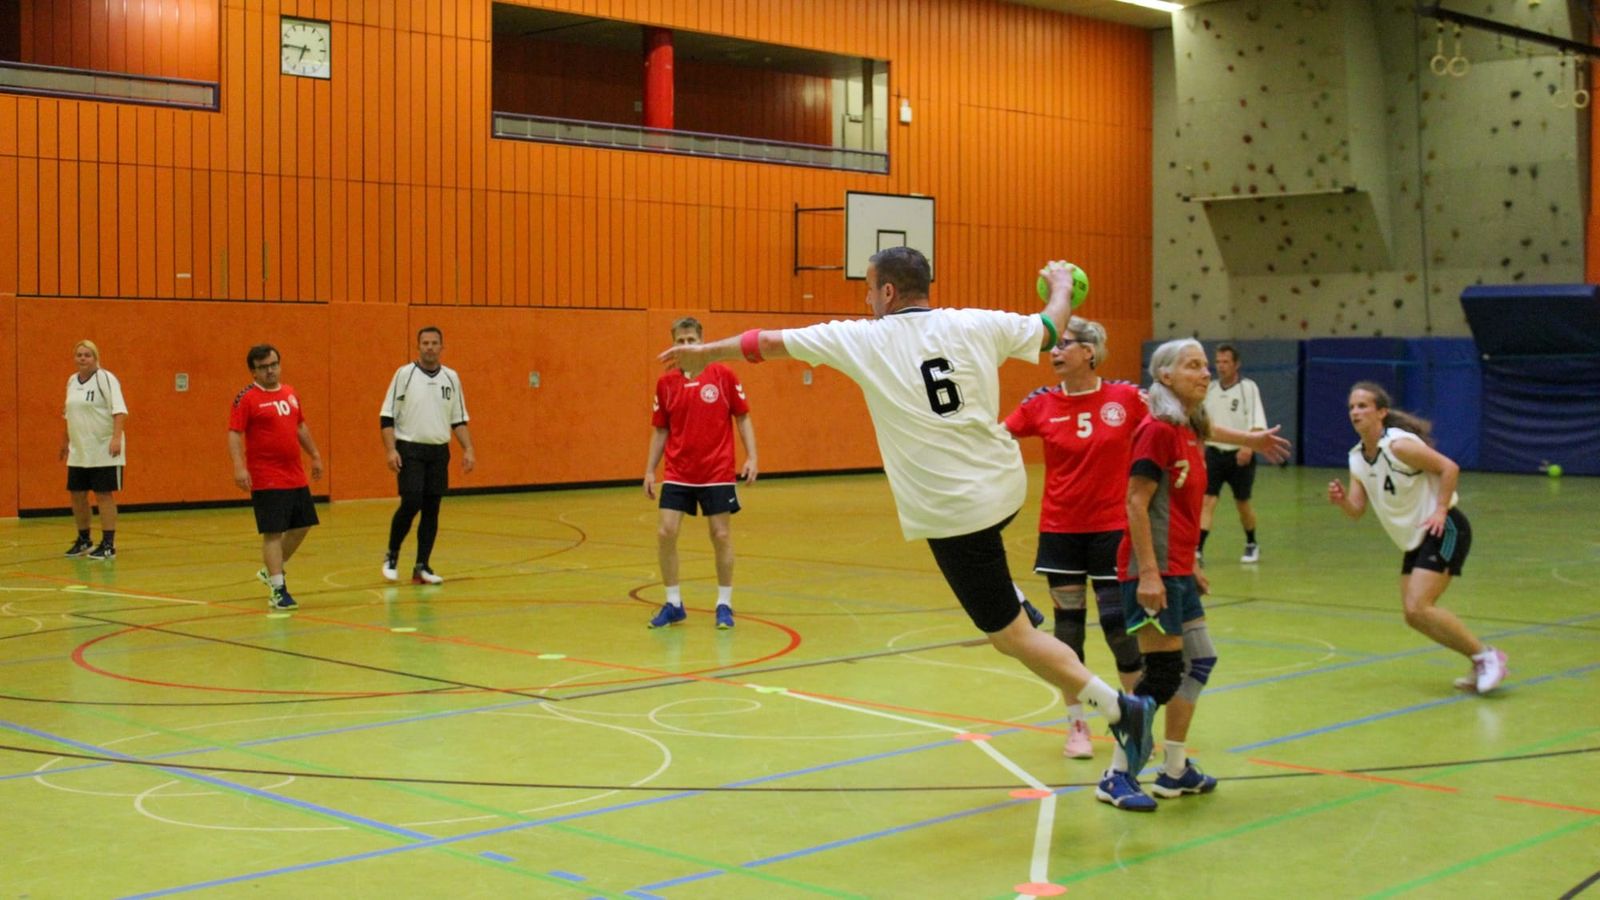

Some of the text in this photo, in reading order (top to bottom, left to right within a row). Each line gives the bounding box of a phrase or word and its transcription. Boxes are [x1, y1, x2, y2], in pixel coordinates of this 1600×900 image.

[86, 390, 95, 402] 11
[440, 386, 452, 401] 10
[920, 357, 965, 418] 6
[272, 400, 291, 416] 10
[1231, 398, 1239, 412] 9
[1076, 412, 1093, 438] 5
[1174, 459, 1190, 488] 7
[1383, 475, 1396, 496] 4
